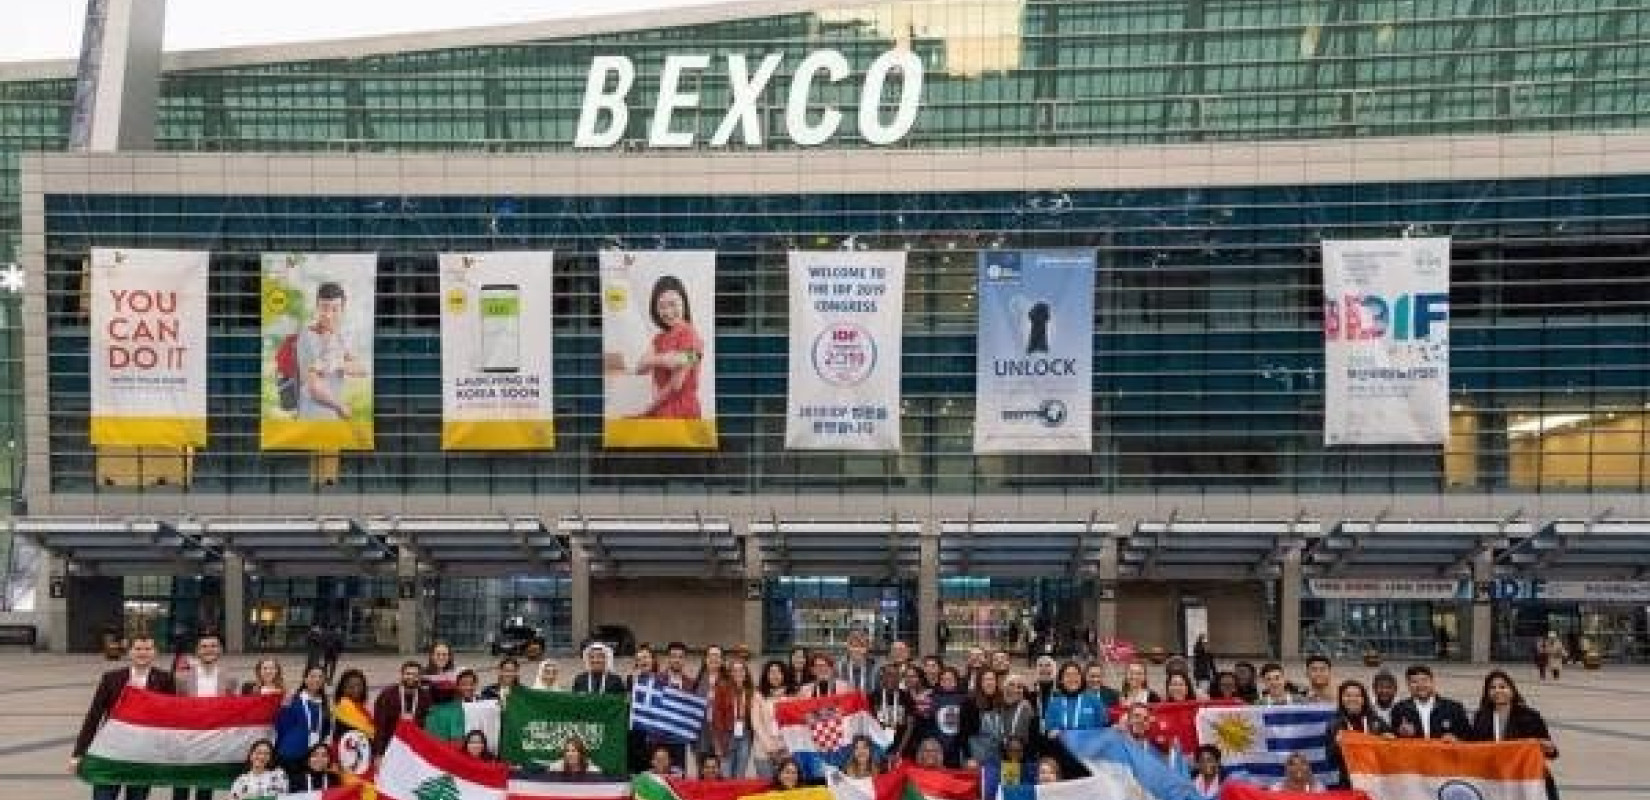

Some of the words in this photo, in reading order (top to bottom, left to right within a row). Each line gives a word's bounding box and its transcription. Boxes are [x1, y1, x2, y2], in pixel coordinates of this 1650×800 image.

[574, 49, 924, 148] BEXCO
[809, 267, 867, 278] WELCOME
[871, 267, 886, 279] TO
[809, 284, 828, 295] THE
[833, 284, 852, 295] IDF
[856, 284, 886, 296] 2019
[109, 289, 176, 312] YOU
[813, 300, 878, 313] CONGRESS
[108, 318, 180, 342] CAN
[833, 330, 858, 341] IDF
[109, 346, 157, 370] DO
[167, 347, 188, 370] IT
[995, 358, 1076, 376] UNLOCK
[456, 376, 523, 387] LAUNCHING
[526, 375, 540, 385] IN
[456, 388, 496, 399] KOREA
[501, 388, 540, 398] SOON
